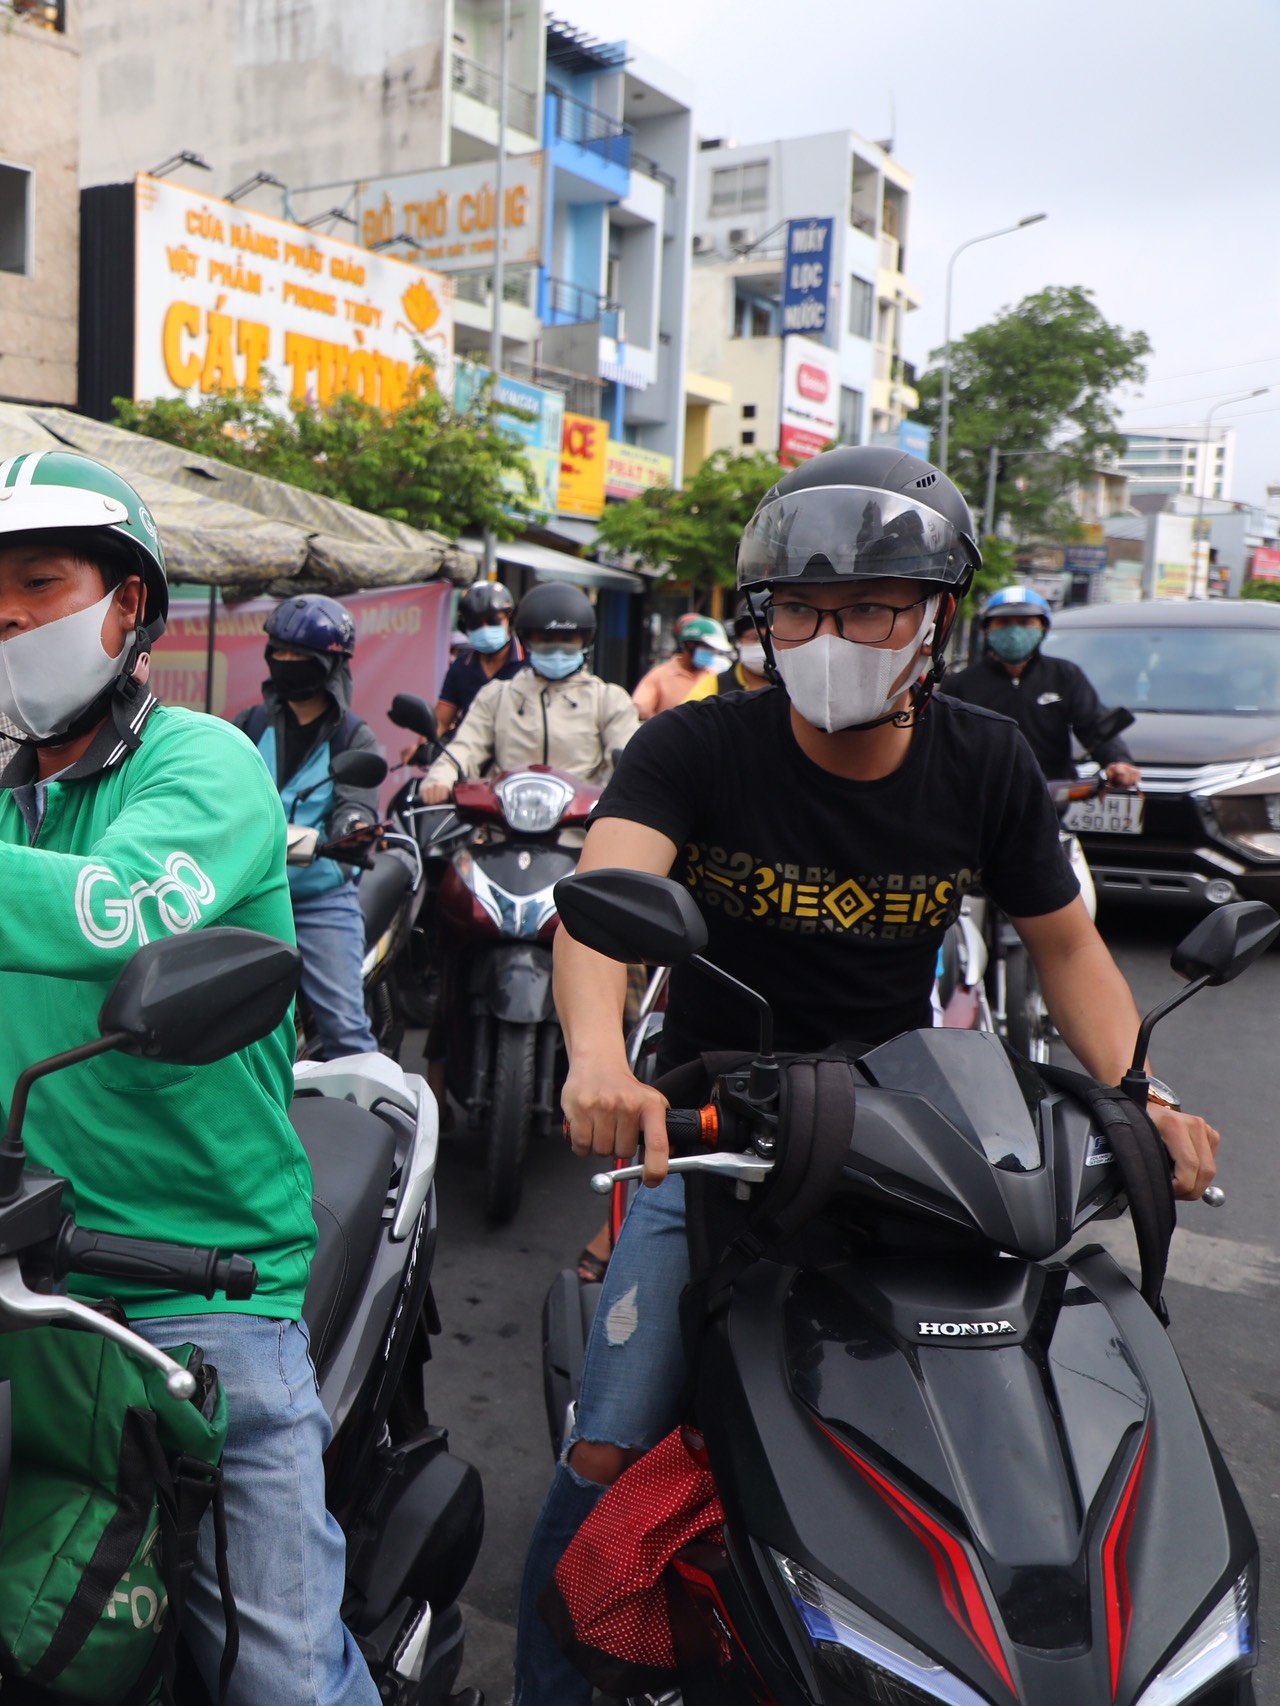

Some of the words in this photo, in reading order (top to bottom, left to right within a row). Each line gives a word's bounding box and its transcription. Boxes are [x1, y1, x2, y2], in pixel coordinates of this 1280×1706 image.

[458, 182, 528, 233] CÚNG
[162, 293, 271, 400] CÁT
[74, 851, 216, 949] Grab
[918, 1320, 1017, 1336] HONDA
